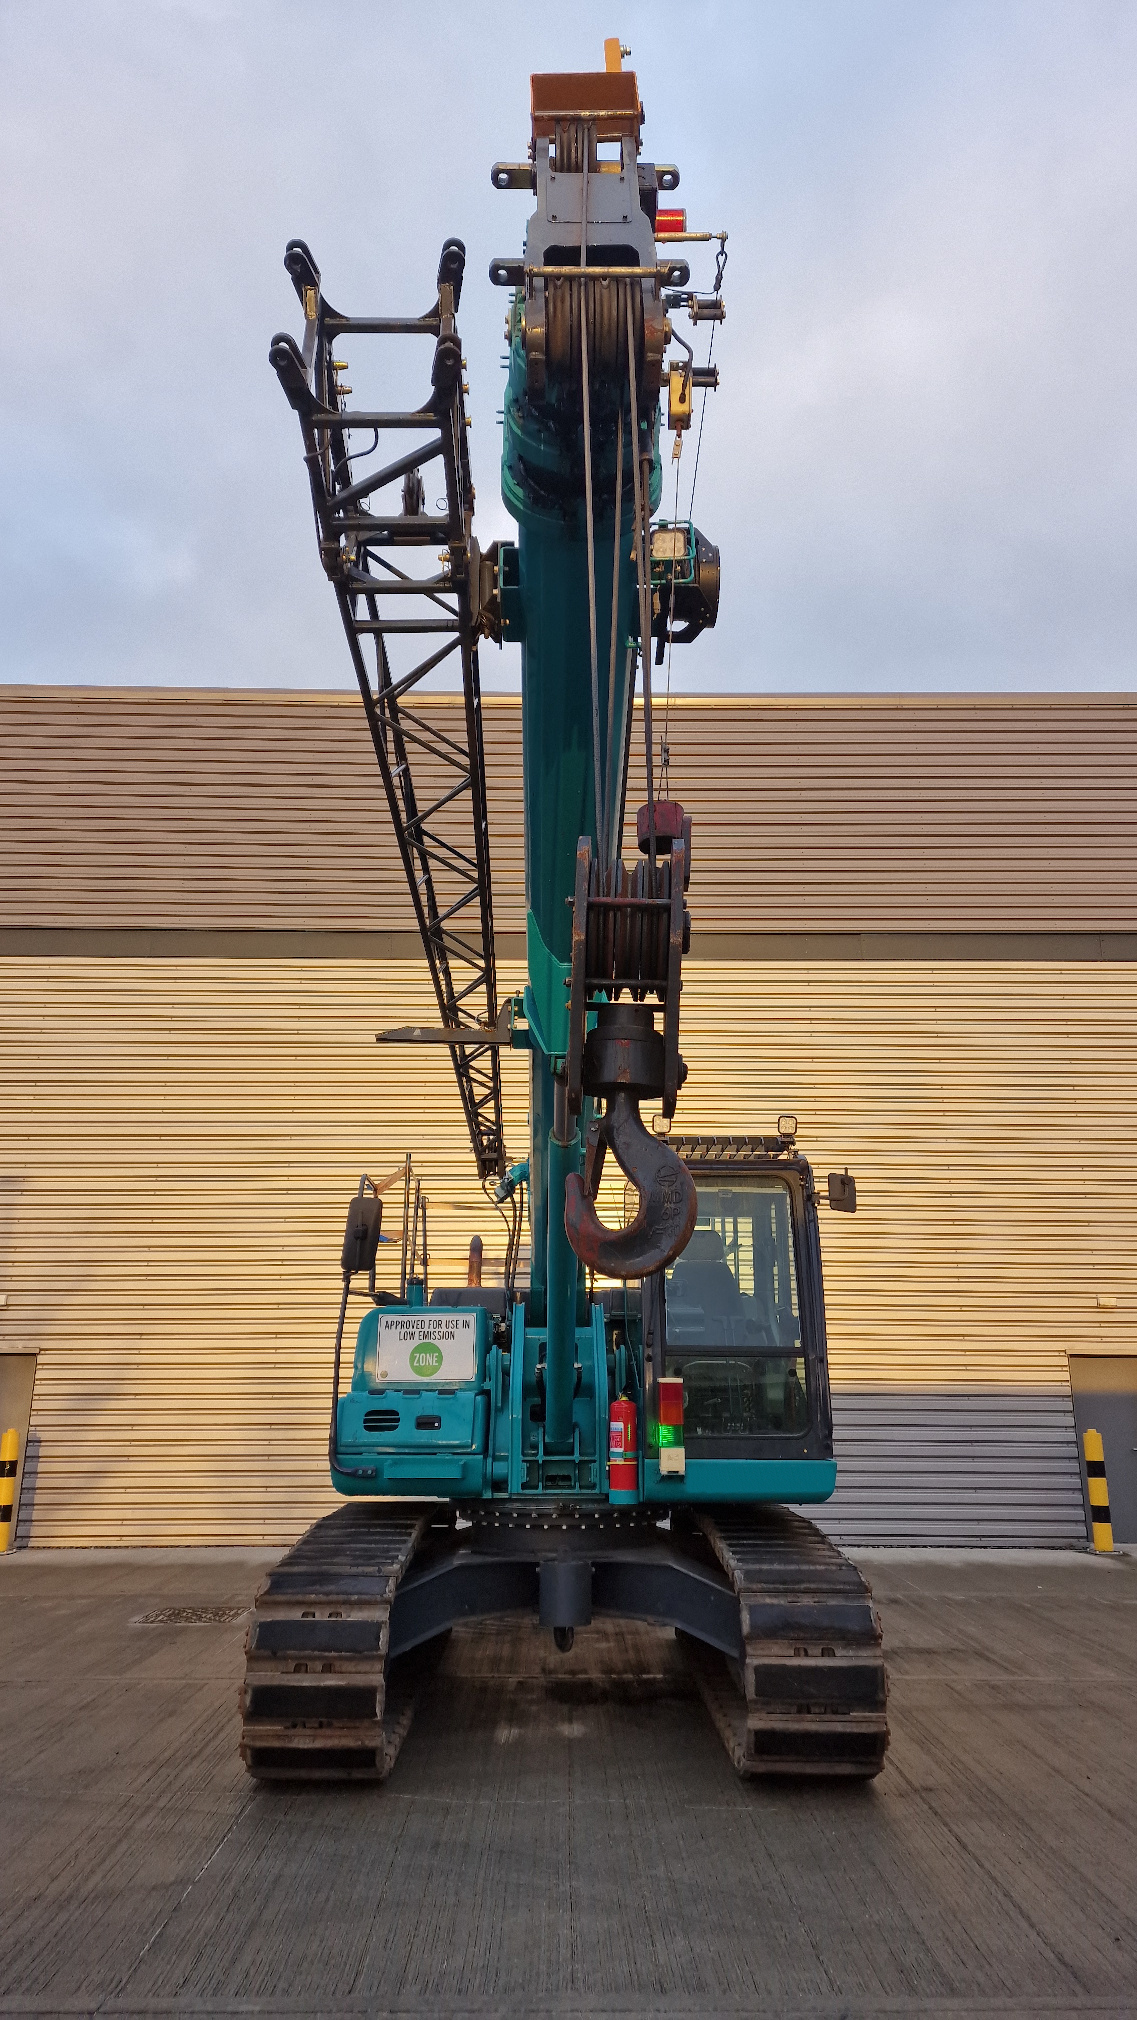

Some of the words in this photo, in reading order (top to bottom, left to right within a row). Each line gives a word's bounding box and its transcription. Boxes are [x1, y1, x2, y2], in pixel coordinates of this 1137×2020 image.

[384, 1320, 425, 1330] APPROVED
[428, 1320, 443, 1330] FOR
[445, 1320, 460, 1329] USE
[462, 1320, 470, 1329] IN
[398, 1331, 416, 1341] LOW
[418, 1331, 455, 1340] EMISSION
[413, 1353, 439, 1366] ZONE
